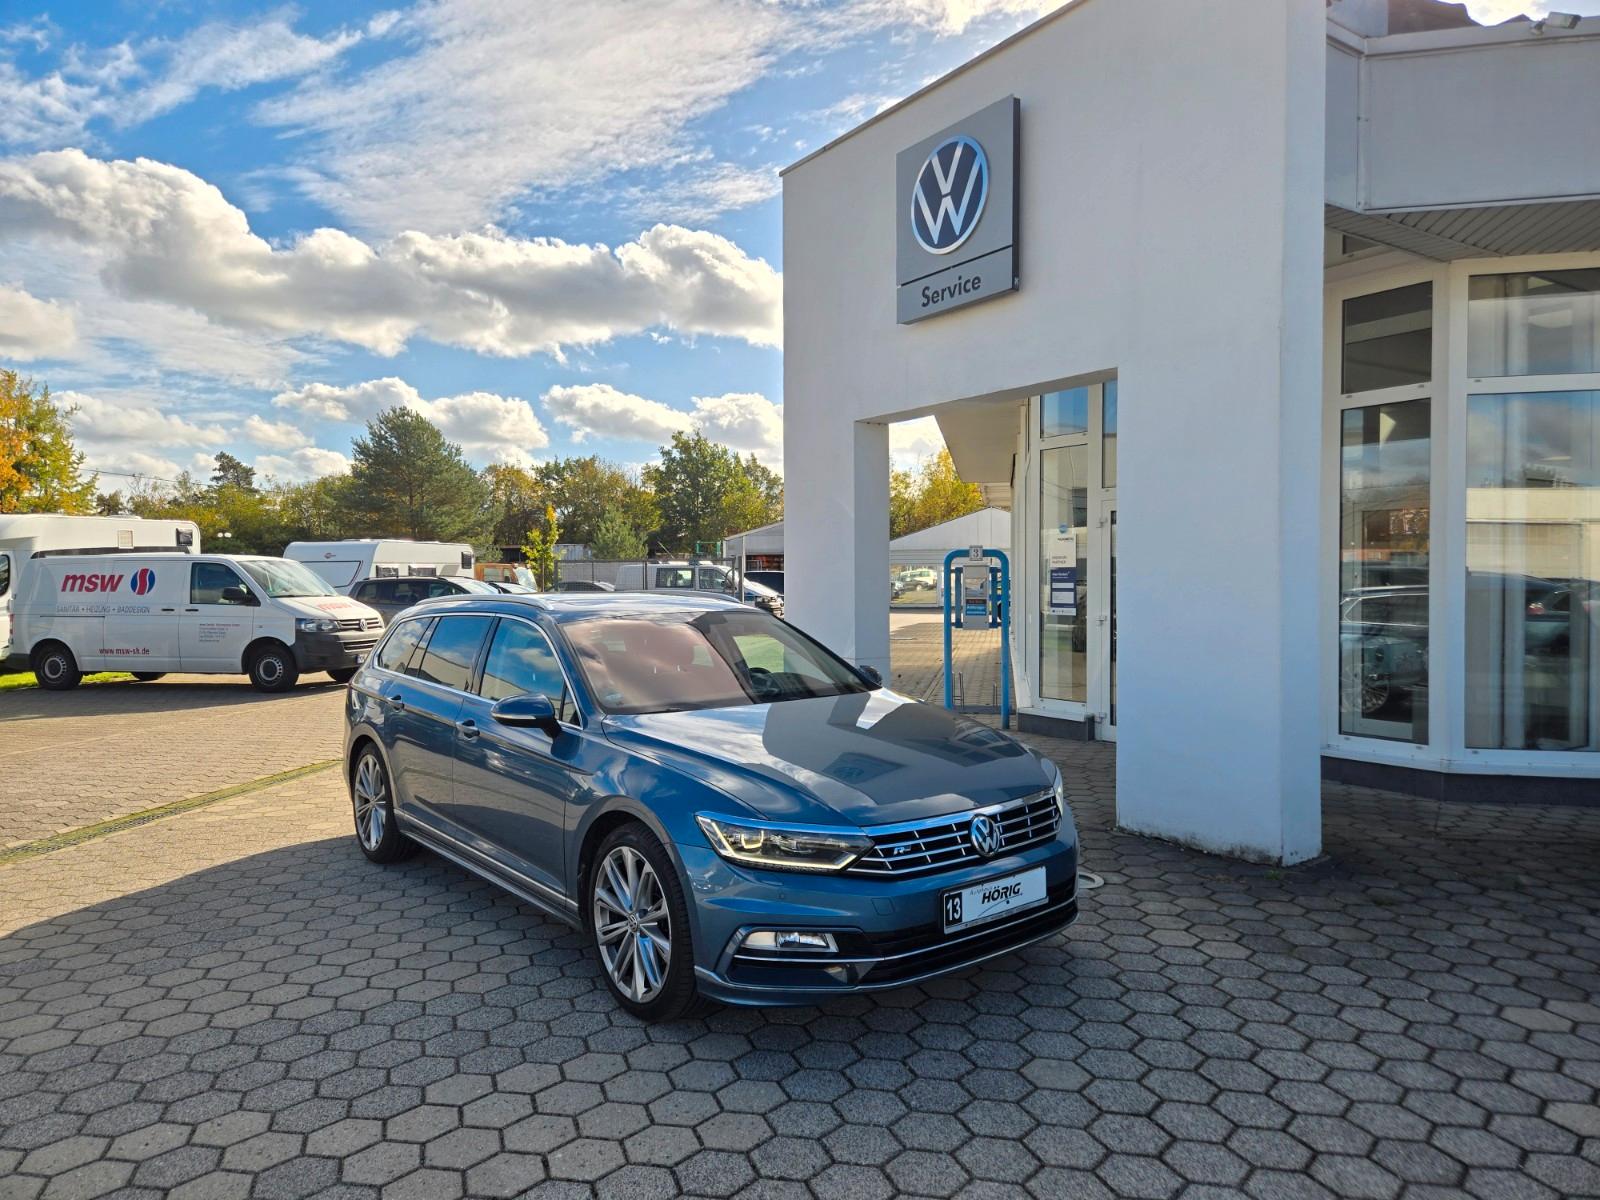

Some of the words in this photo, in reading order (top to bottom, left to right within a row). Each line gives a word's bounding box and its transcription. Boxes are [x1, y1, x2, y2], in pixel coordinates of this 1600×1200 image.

[921, 275, 981, 307] Service
[973, 549, 979, 558] 3
[61, 574, 124, 592] msw
[981, 882, 1021, 904] HÖRIG
[946, 897, 961, 921] 13
